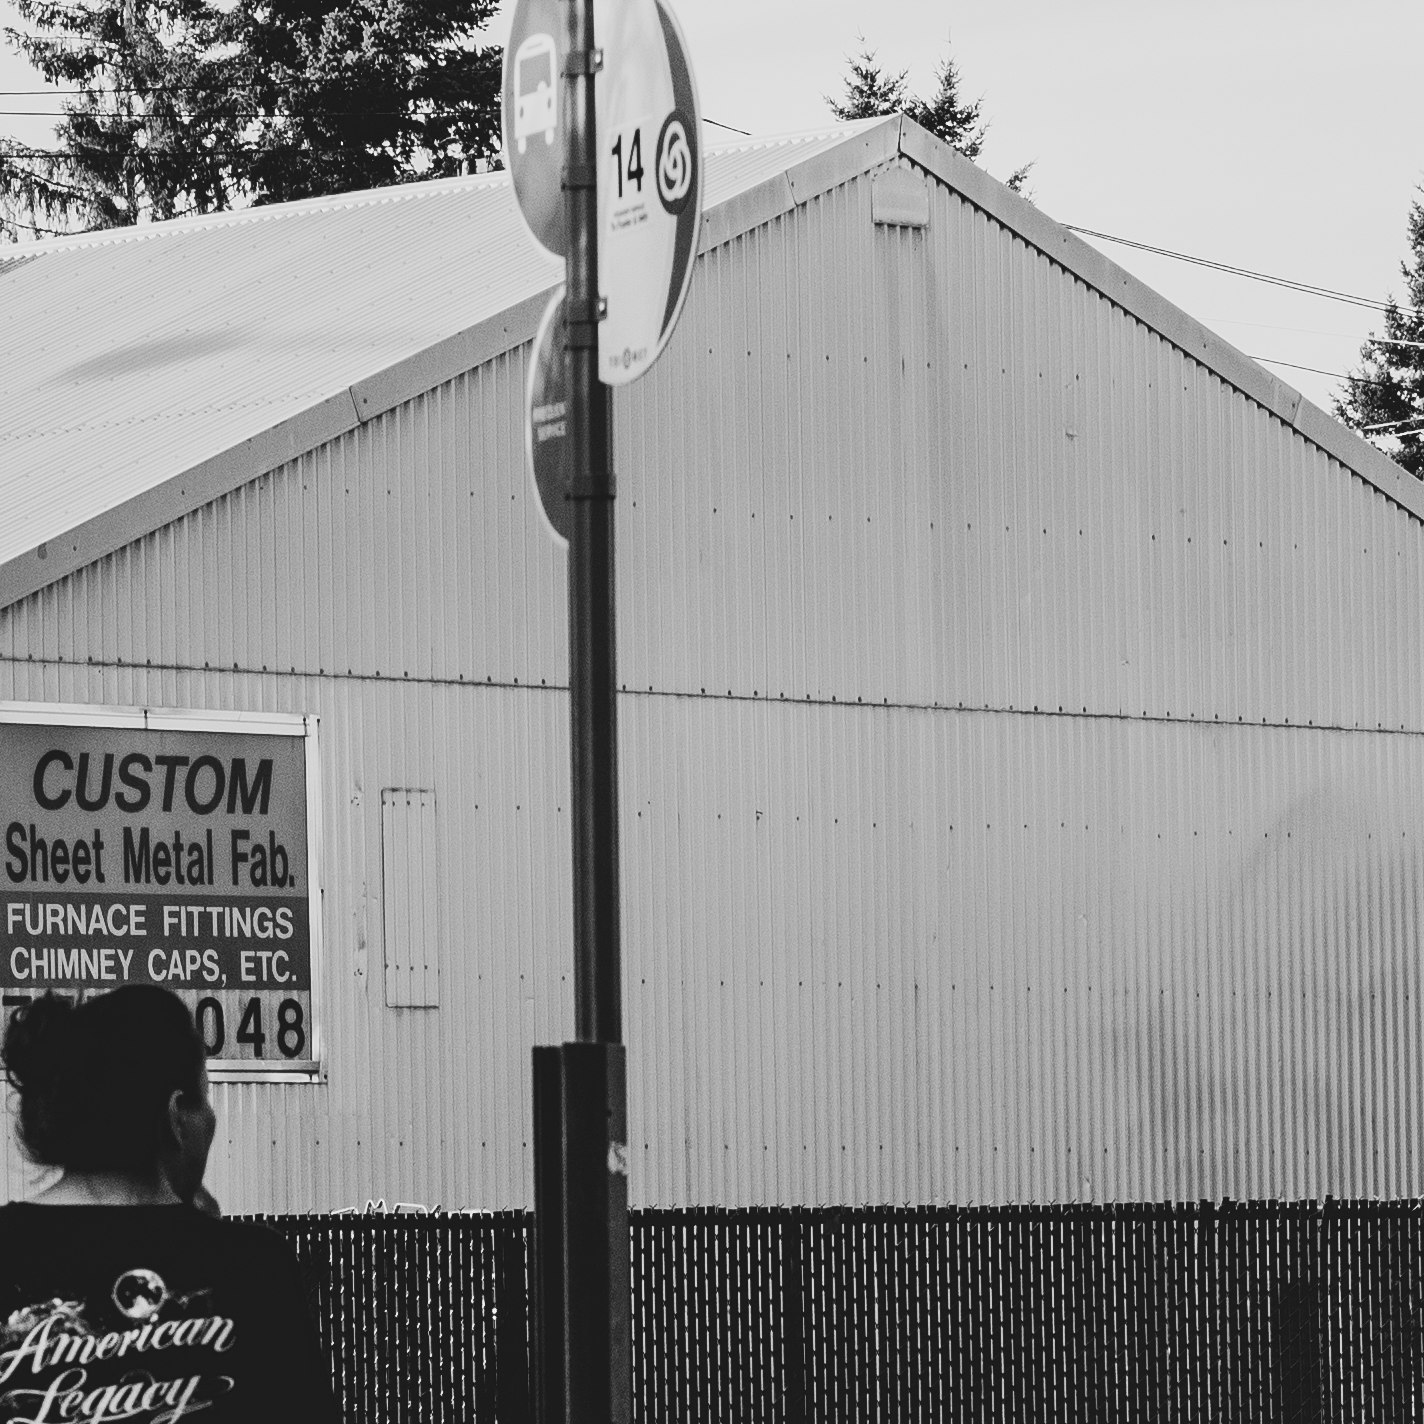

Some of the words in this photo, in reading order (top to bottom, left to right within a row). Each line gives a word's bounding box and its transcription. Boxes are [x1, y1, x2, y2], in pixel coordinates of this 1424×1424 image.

[611, 128, 644, 198] 14
[33, 749, 274, 815] CUSTOM
[5, 821, 105, 884] Sheet
[123, 826, 214, 886] Metal
[231, 829, 296, 888] Fab.
[7, 903, 147, 937] FURNACE
[163, 905, 294, 939] FITTINGS
[10, 946, 134, 981] CHIMNEY
[147, 948, 227, 987] CAPS,
[240, 950, 297, 982] ETC.
